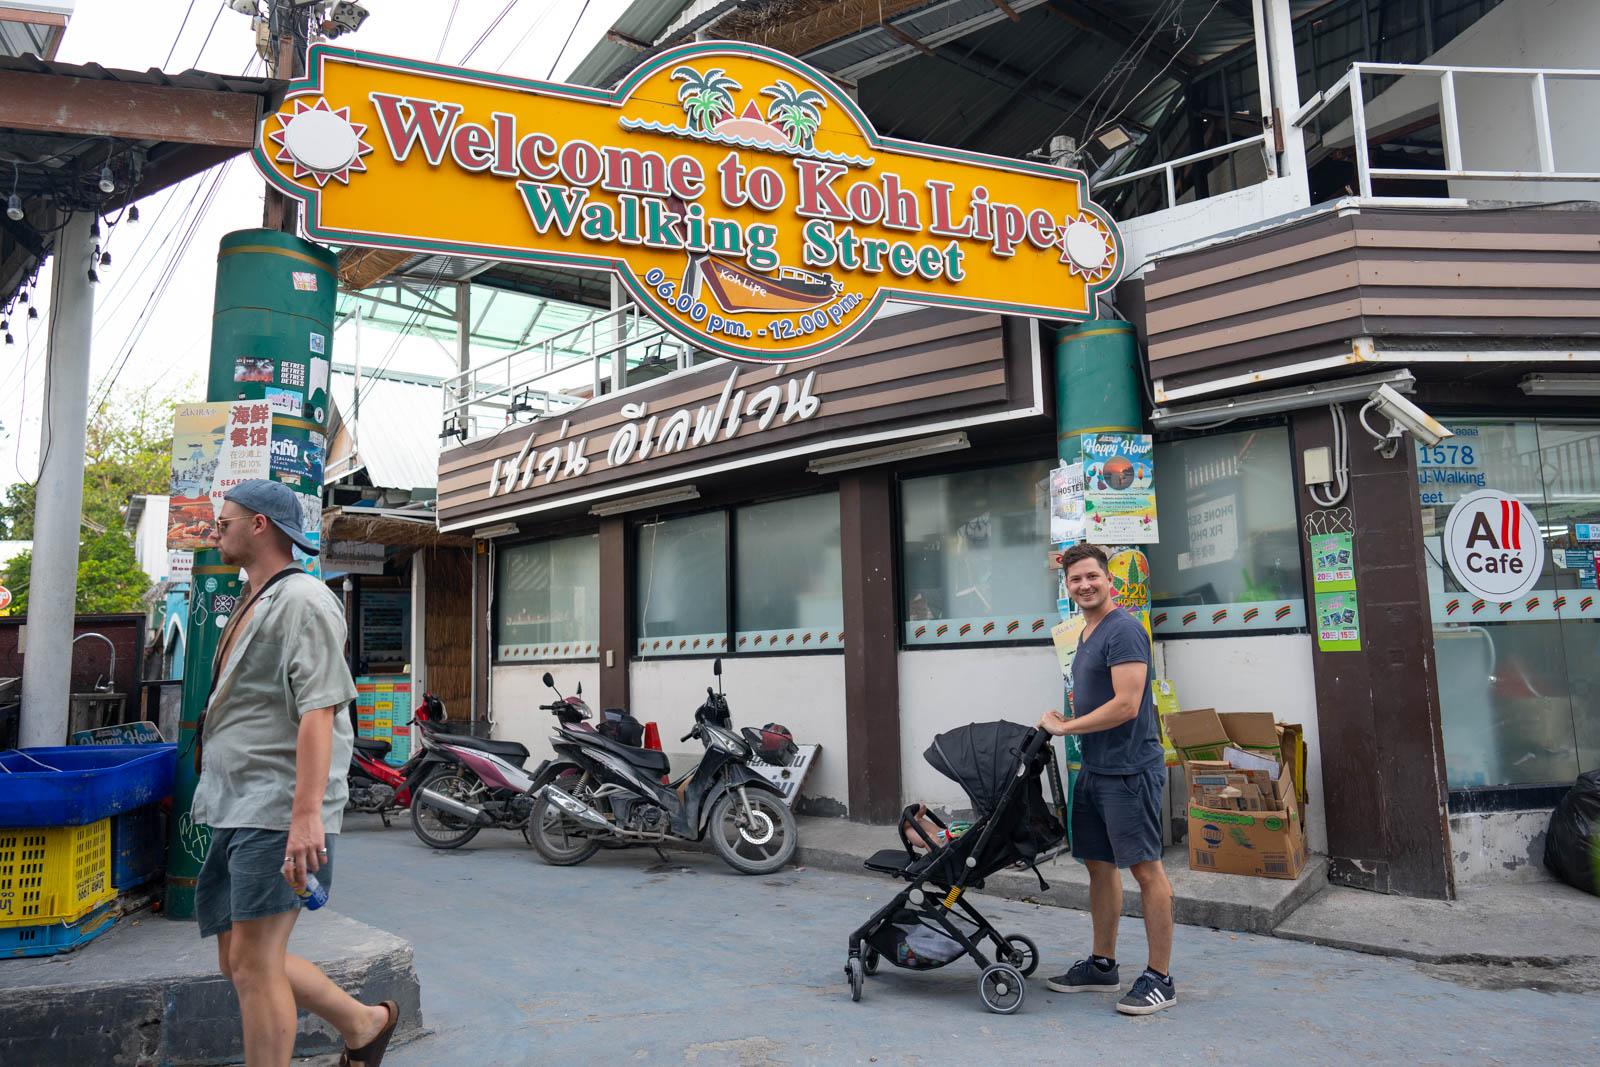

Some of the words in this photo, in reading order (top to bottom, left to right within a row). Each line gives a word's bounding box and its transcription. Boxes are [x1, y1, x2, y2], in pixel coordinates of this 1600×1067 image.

[369, 92, 705, 201] Welcome
[718, 151, 785, 210] to
[793, 158, 921, 232] Koh
[927, 180, 1057, 256] Lipe
[516, 181, 779, 271] Walking
[804, 220, 966, 282] Street
[719, 269, 742, 287] Koh
[742, 278, 768, 298] Lipe
[645, 267, 707, 321] 06.00
[707, 313, 752, 338] pm.
[768, 310, 829, 339] 12.00
[827, 292, 863, 323] pm.
[231, 403, 270, 425] 海鲜
[230, 426, 268, 447] 餐馆
[1083, 439, 1119, 456] Happy
[1121, 439, 1152, 455] Hour
[1420, 445, 1474, 464] 1578
[488, 419, 590, 498] เซเว่น
[1433, 470, 1485, 486] Walking
[1419, 491, 1444, 504] eet
[1466, 500, 1521, 549] All
[1466, 552, 1523, 574] Café
[1317, 573, 1326, 581] 20
[1119, 580, 1147, 599] 420
[1322, 632, 1330, 640] 20
[1341, 631, 1348, 639] 15
[124, 729, 159, 744] Hour
